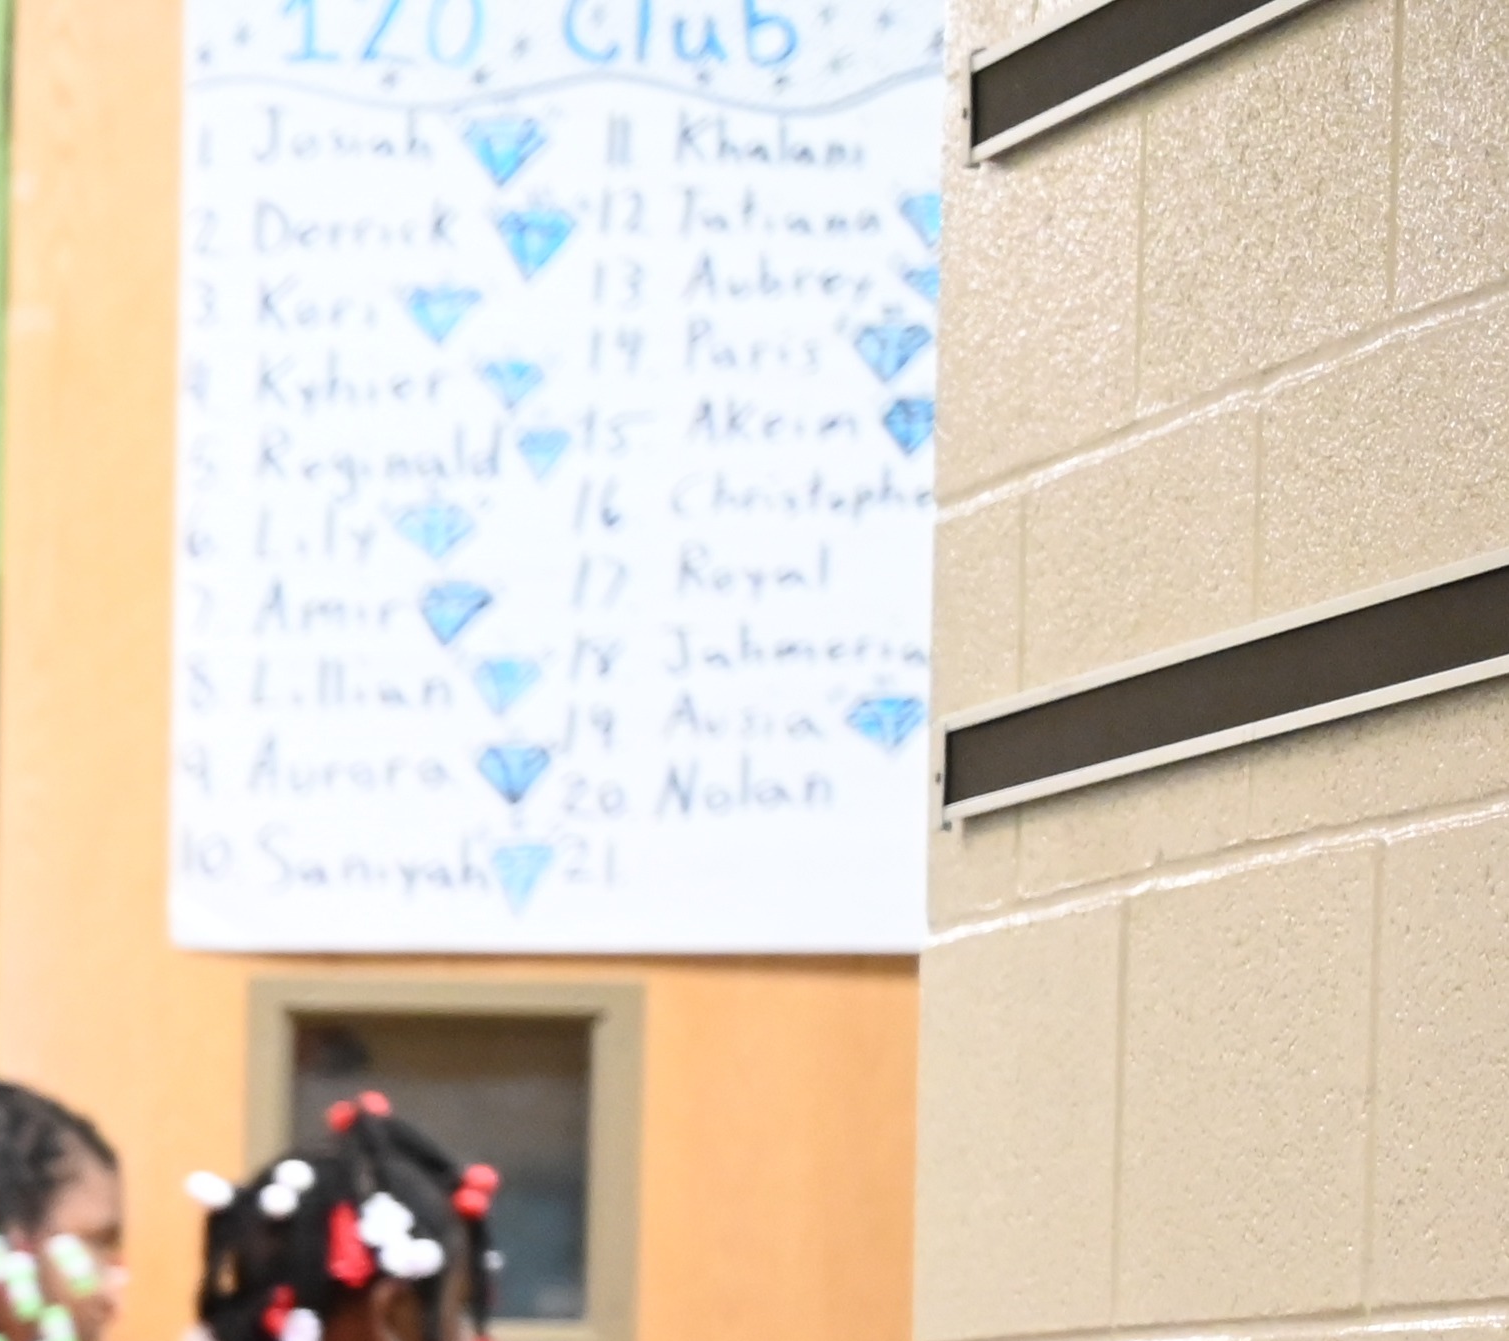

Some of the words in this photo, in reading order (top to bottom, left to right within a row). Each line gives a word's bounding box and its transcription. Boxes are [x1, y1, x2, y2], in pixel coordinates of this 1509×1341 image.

[560, 0, 801, 70] Club
[254, 197, 459, 255] Derrick
[670, 465, 935, 525] Christophe
[676, 540, 831, 601] Royal
[252, 577, 400, 635] Amir
[247, 729, 453, 795] Aurora
[655, 751, 835, 822] Nolan
